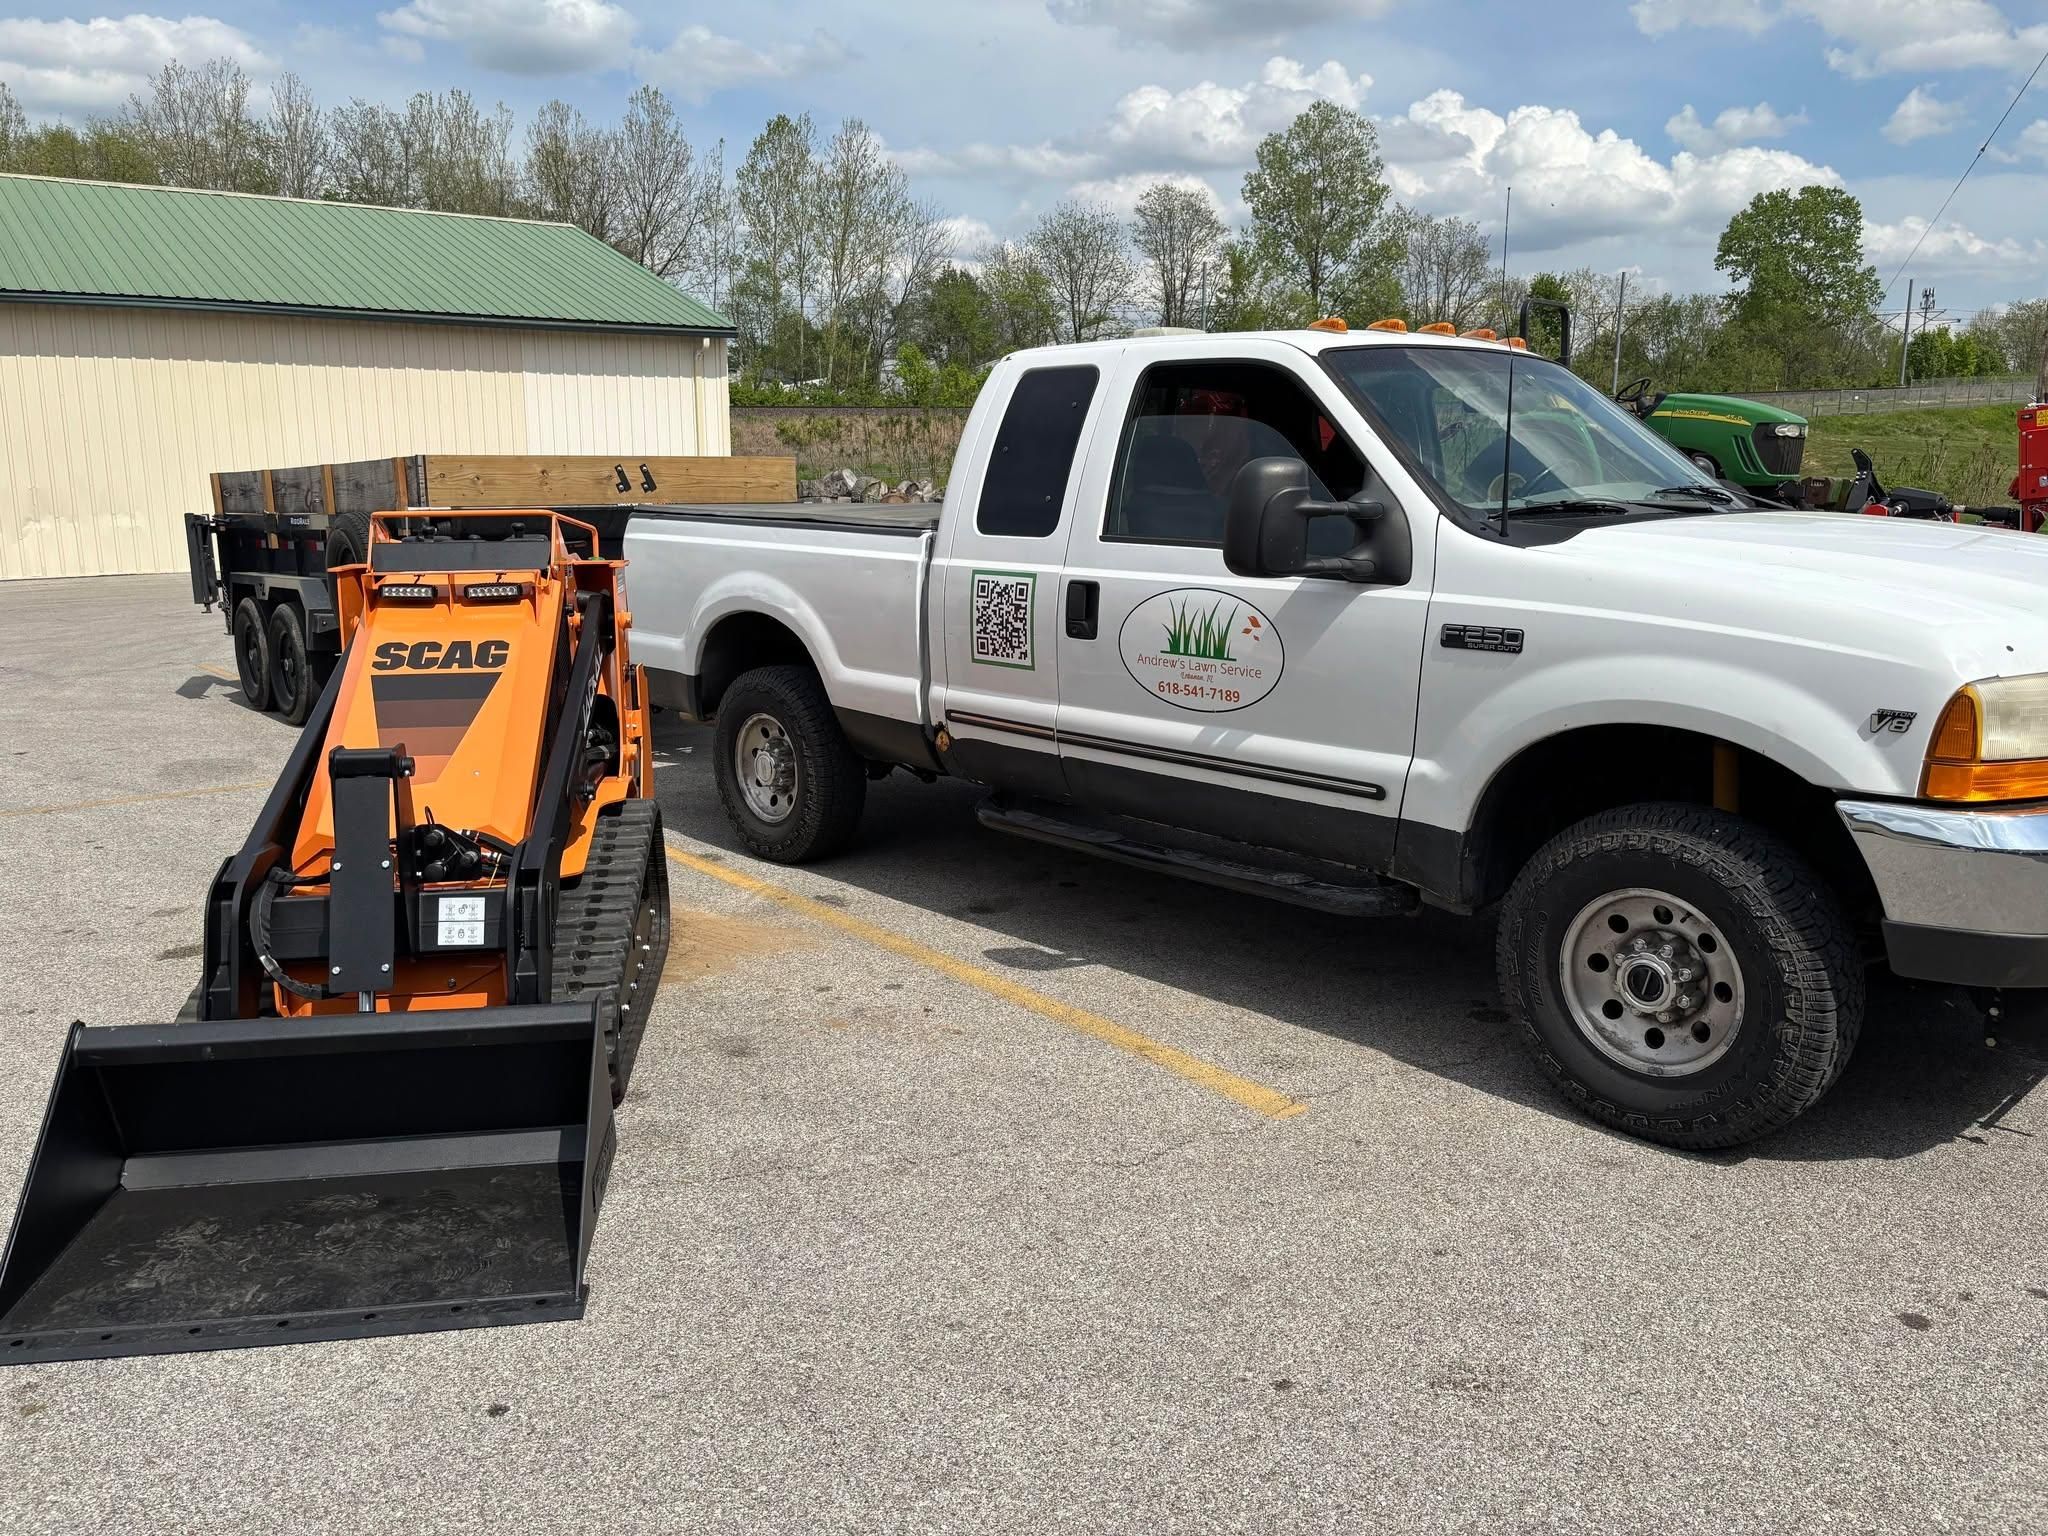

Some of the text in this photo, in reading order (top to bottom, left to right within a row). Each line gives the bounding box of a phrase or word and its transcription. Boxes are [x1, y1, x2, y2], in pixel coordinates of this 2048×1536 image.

[371, 640, 510, 671] SCAG
[1467, 642, 1496, 650] SUPER
[1137, 653, 1262, 679] Andrew's Lawn Service
[1158, 681, 1240, 703] 618-541-7189
[1870, 713, 1912, 733] V8
[1879, 709, 1917, 718] TRITON
